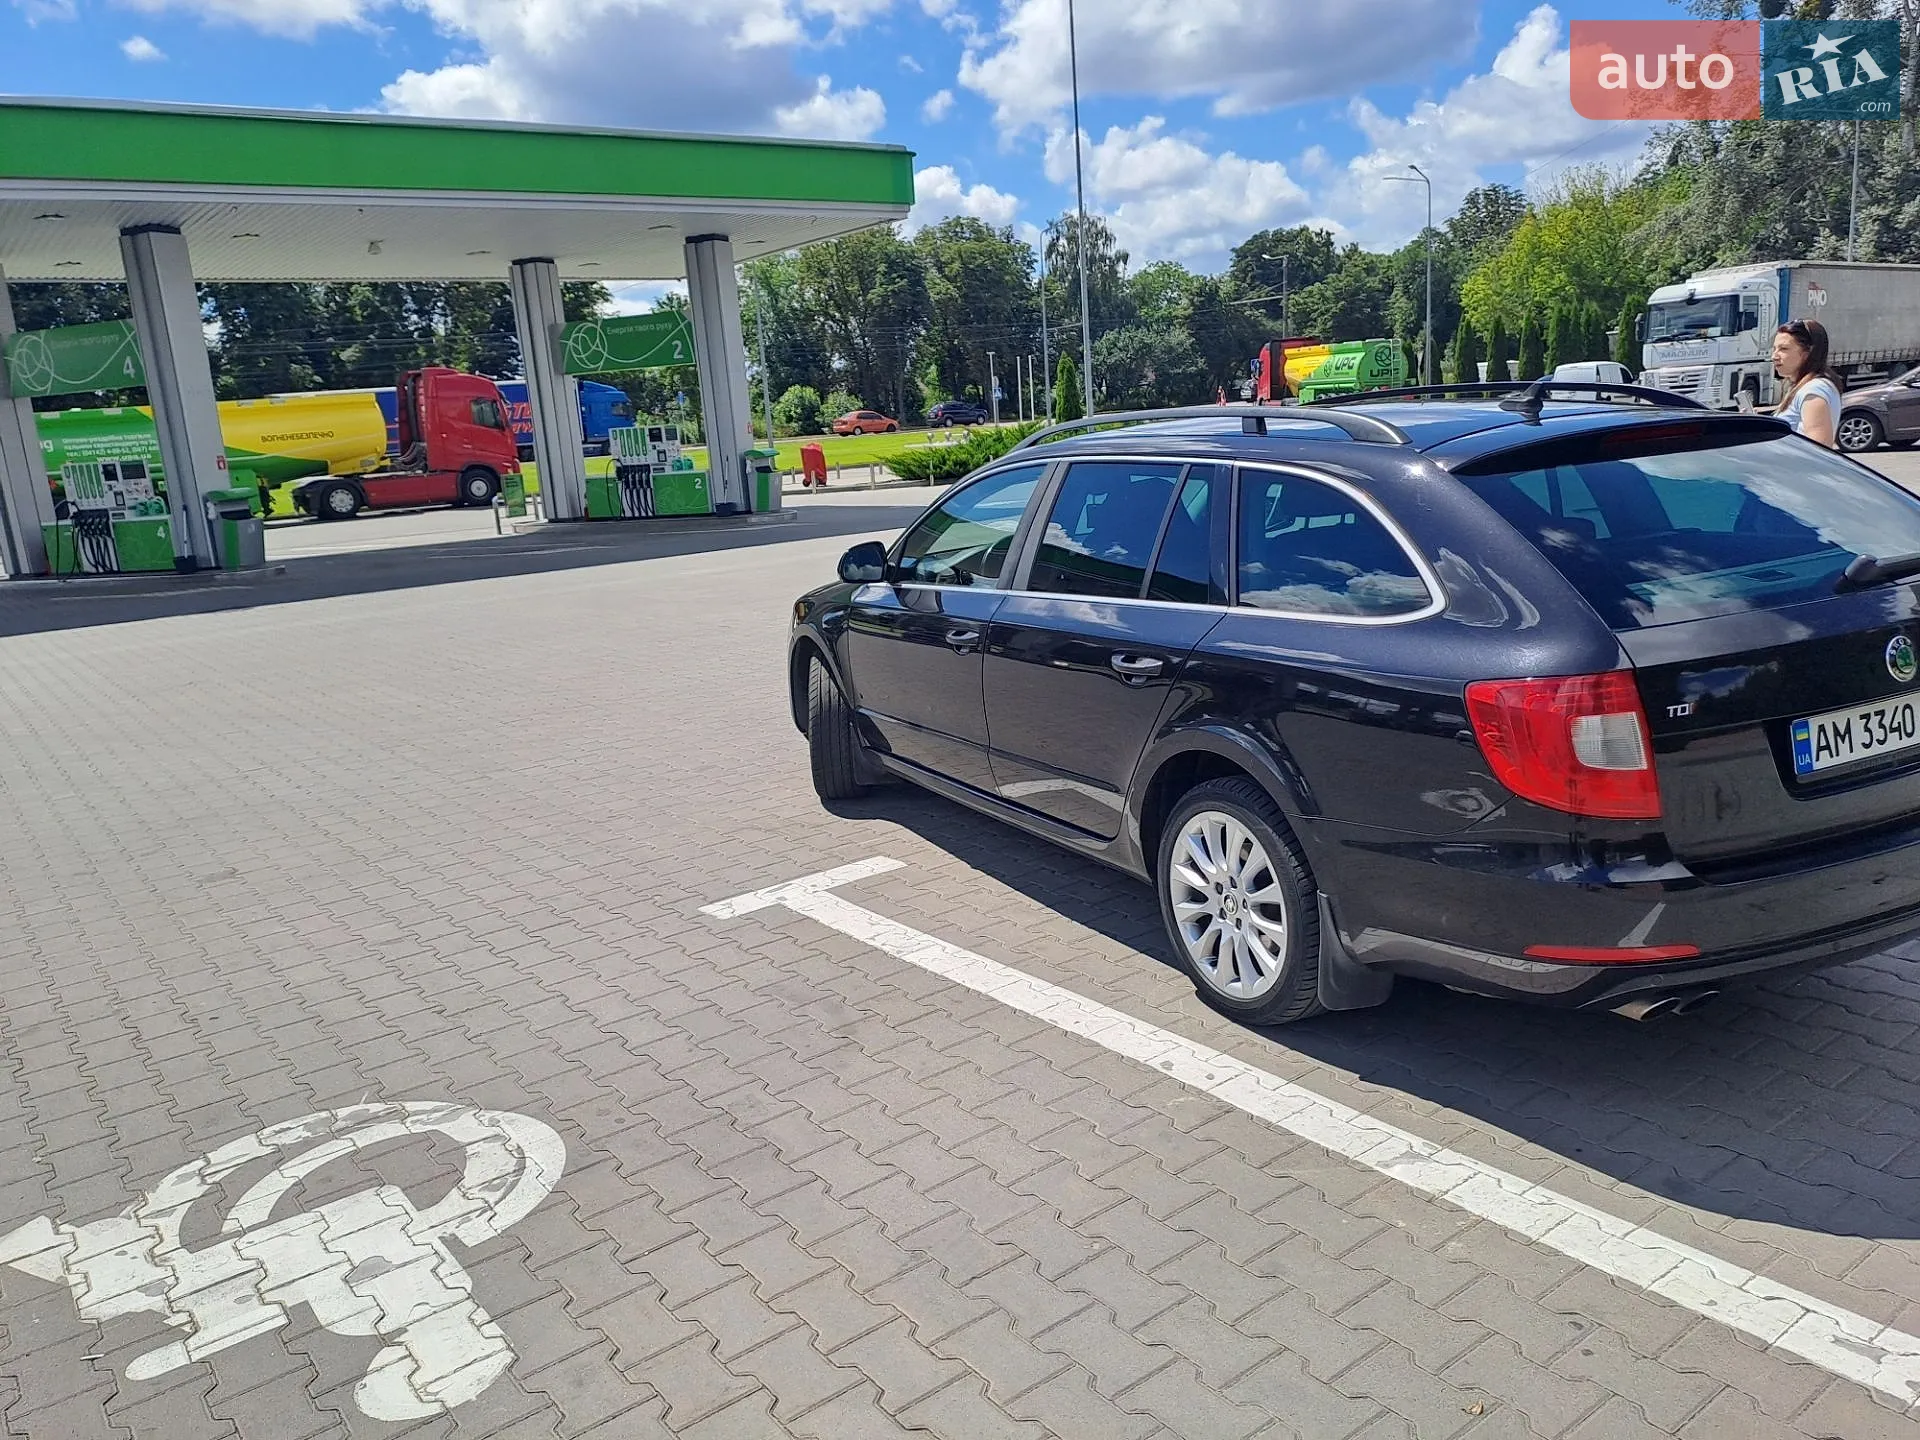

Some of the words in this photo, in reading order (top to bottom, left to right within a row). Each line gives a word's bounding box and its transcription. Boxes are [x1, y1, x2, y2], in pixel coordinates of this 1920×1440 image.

[671, 339, 684, 359] 2
[123, 355, 136, 379] 4
[1334, 356, 1357, 371] UPG
[261, 430, 335, 443] ВОГНЕНЕБЕЗПЕЧНО
[694, 477, 703, 489] 2
[155, 525, 166, 539] 4
[1666, 702, 1694, 718] TDI
[1815, 717, 1854, 762] AM
[1859, 703, 1916, 749] 3340
[1798, 753, 1812, 766] UA
